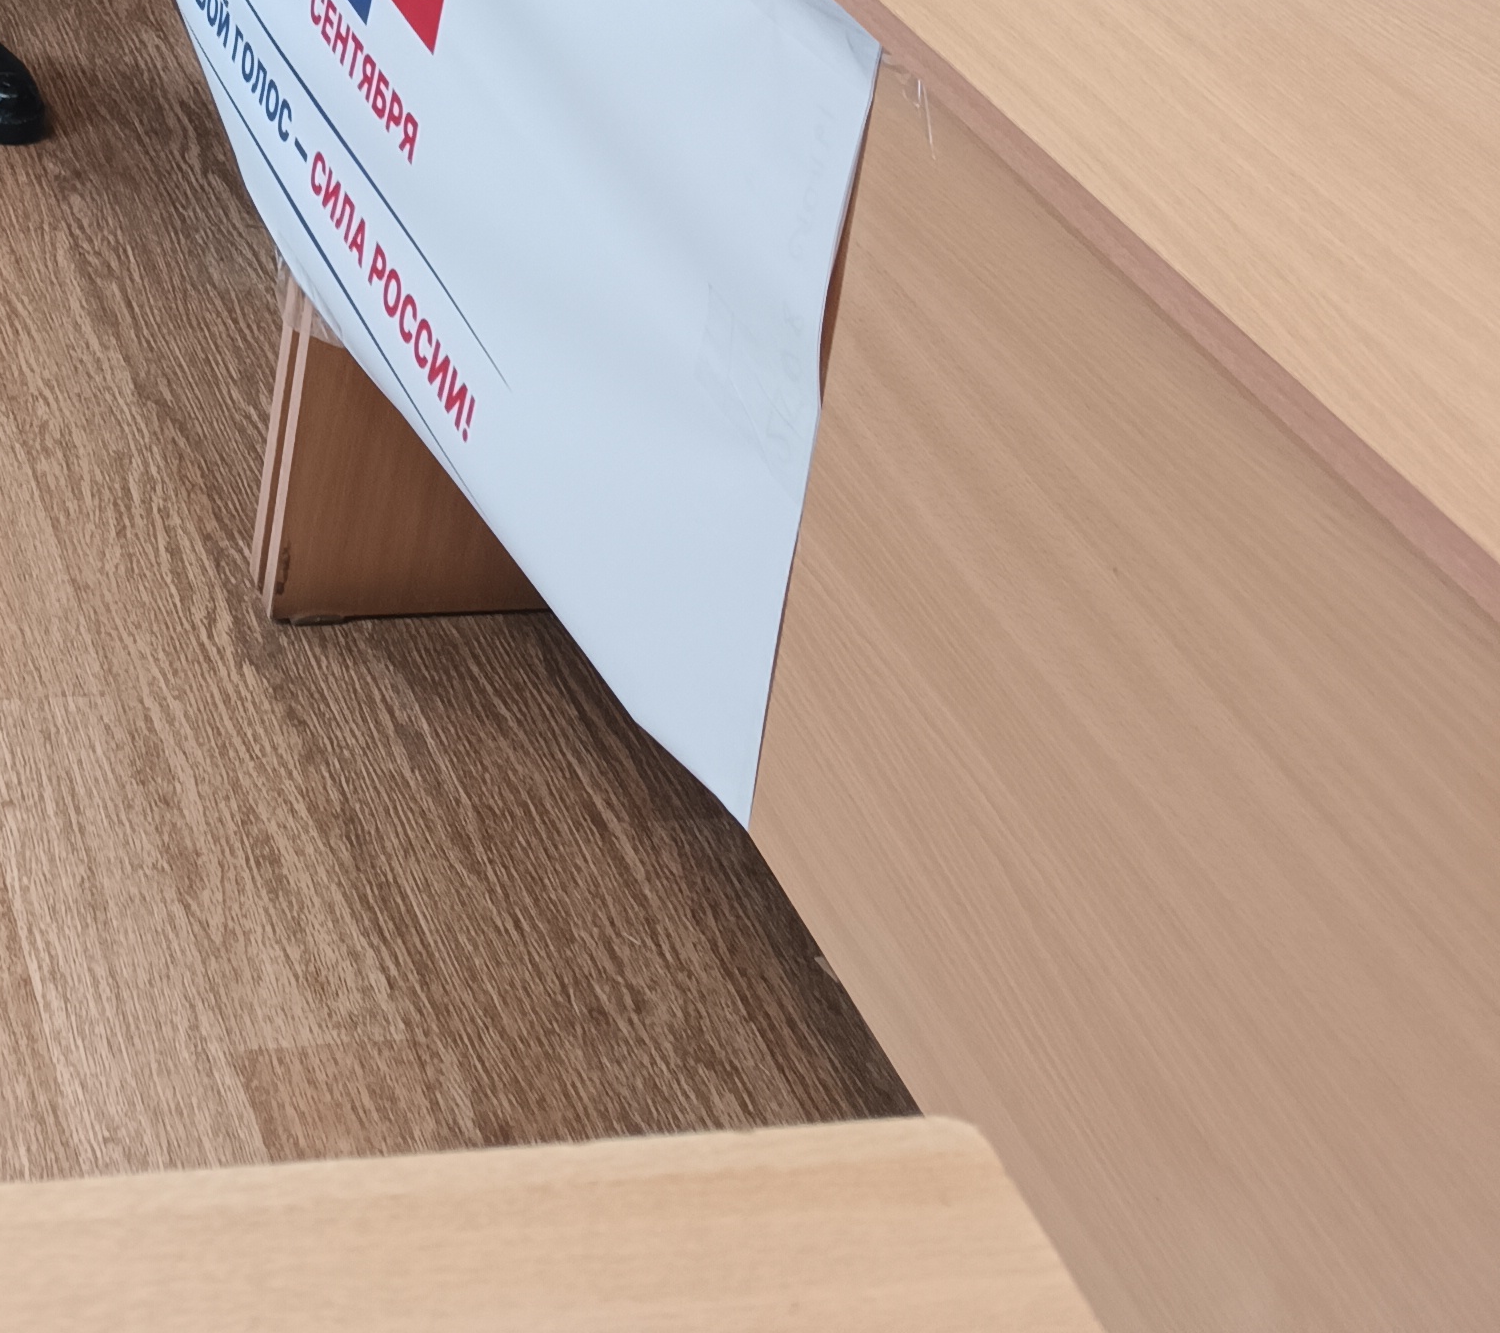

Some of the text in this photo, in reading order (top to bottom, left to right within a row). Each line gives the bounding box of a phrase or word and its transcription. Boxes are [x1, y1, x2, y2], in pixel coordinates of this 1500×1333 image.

[231, 21, 292, 141] ГОЛОС
[311, 151, 365, 268] СИЛА
[368, 241, 476, 443] РОССИИ!
